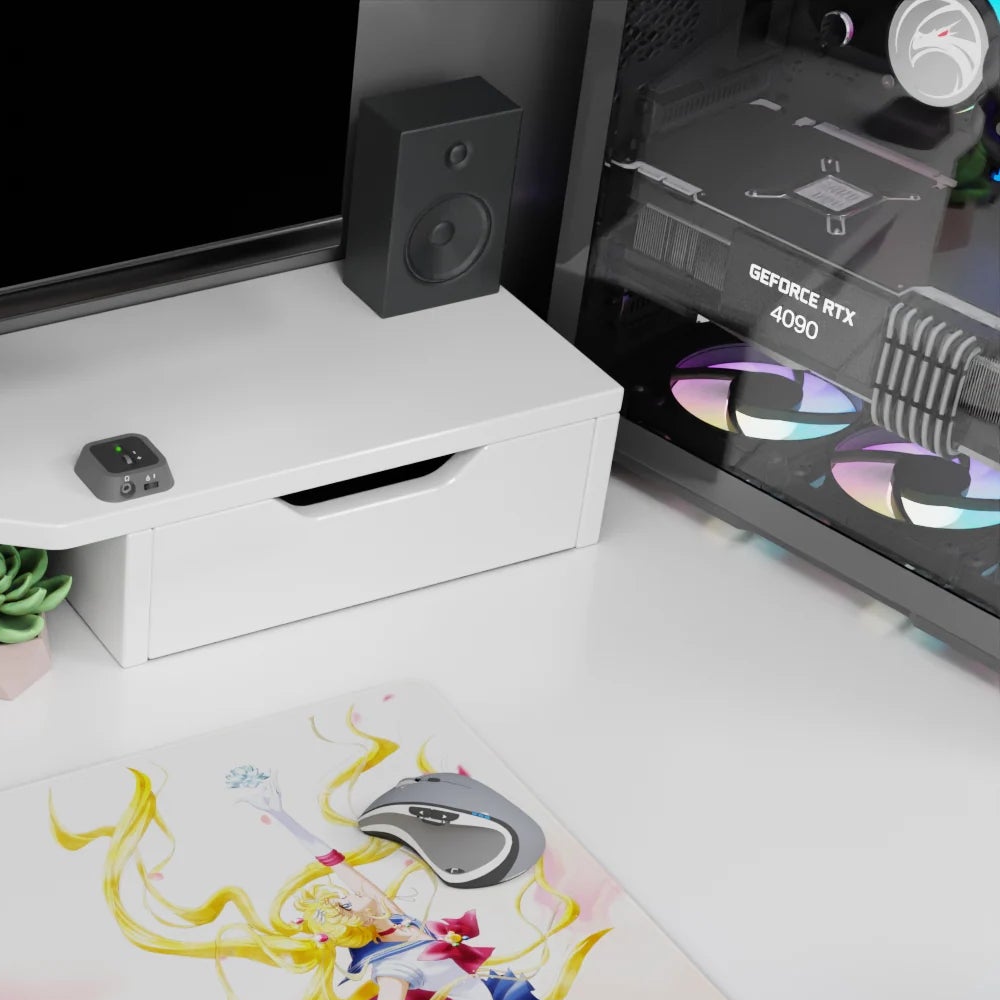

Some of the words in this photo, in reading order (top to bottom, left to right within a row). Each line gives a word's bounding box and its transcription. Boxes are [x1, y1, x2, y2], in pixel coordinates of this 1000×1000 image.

[749, 263, 821, 309] GEFORCE
[822, 297, 857, 327] RTX
[770, 305, 819, 340] 4090
